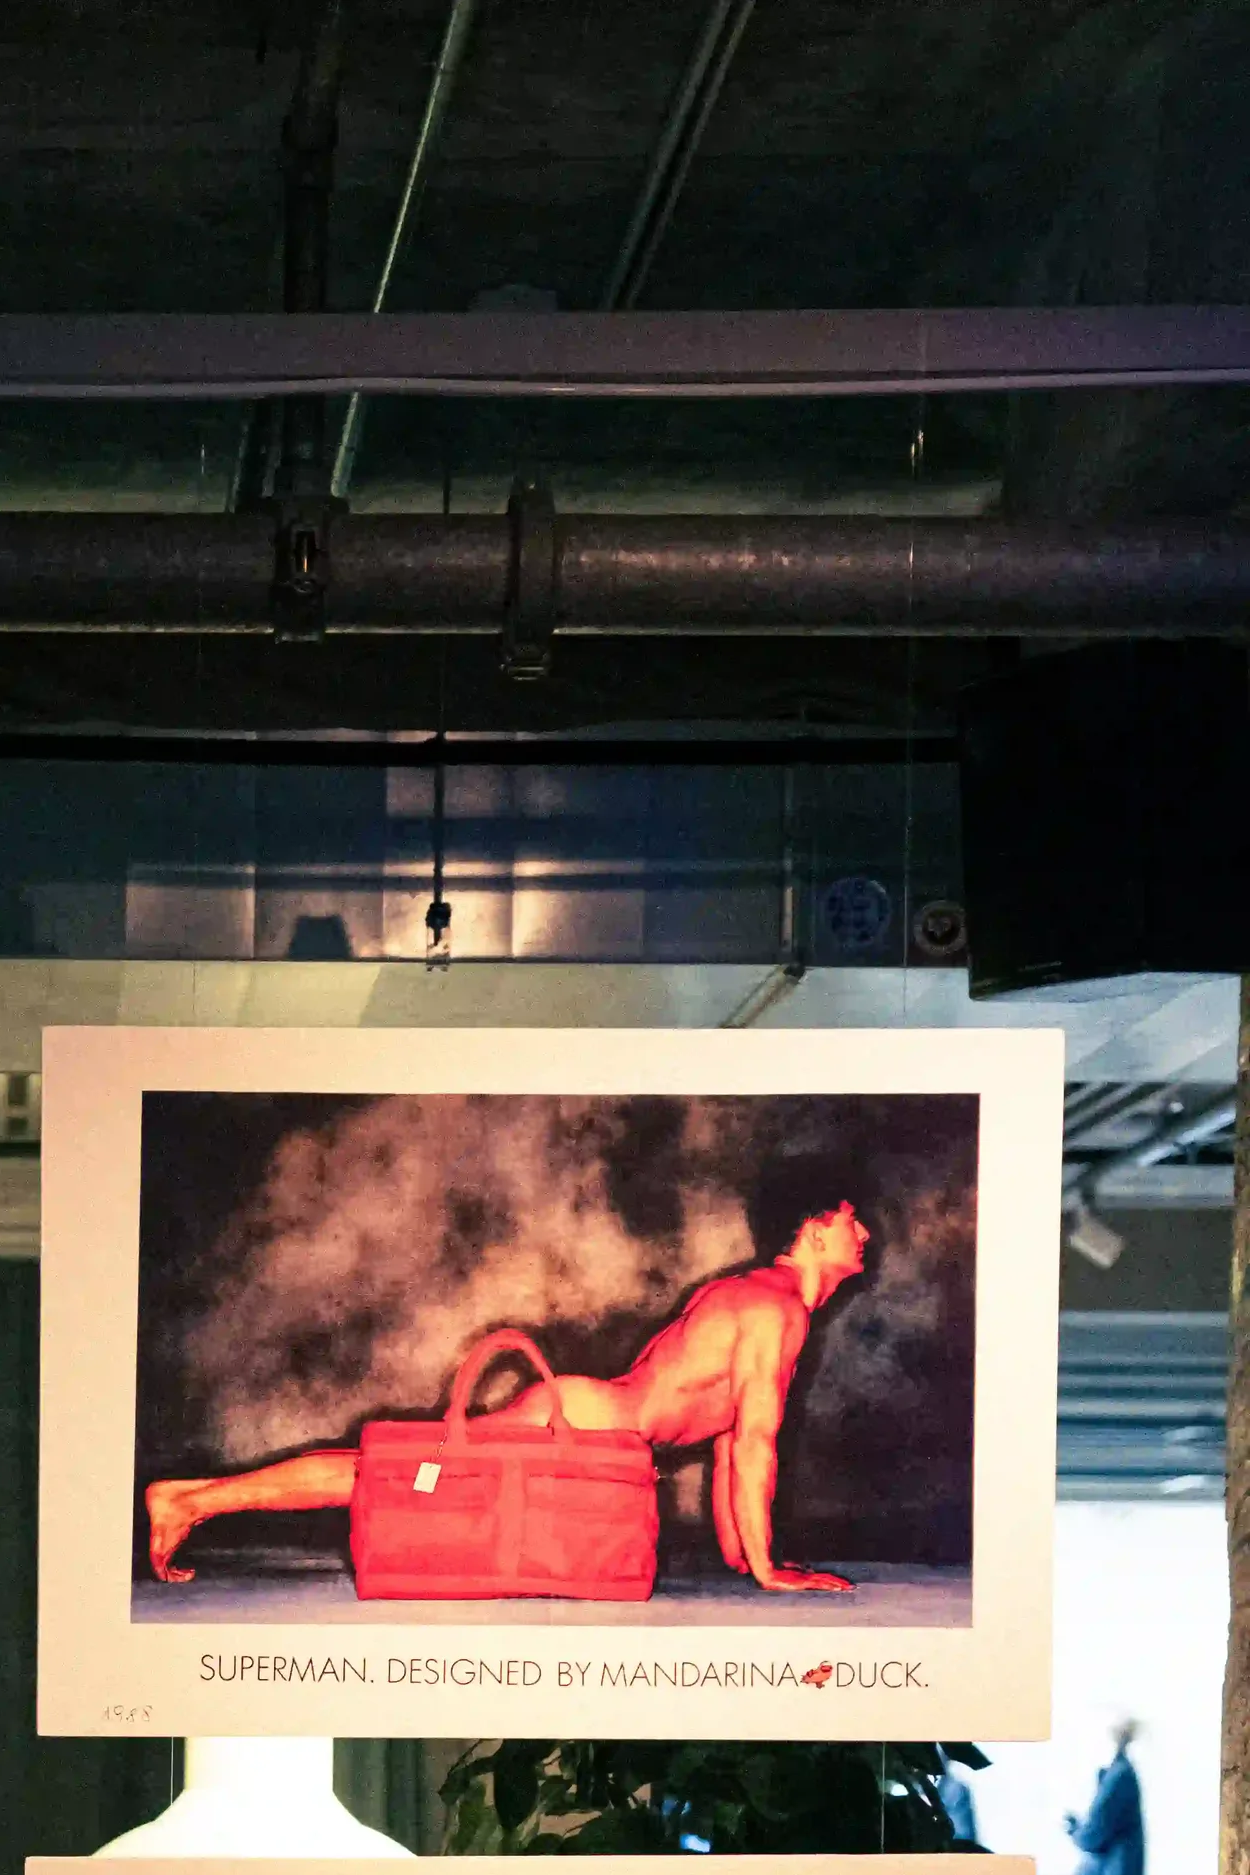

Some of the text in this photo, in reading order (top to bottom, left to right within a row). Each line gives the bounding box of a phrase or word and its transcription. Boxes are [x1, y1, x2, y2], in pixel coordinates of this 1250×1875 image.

[199, 1653, 930, 1688] SUPERMAN. DESIGNED BY MANDARINA DUCK.
